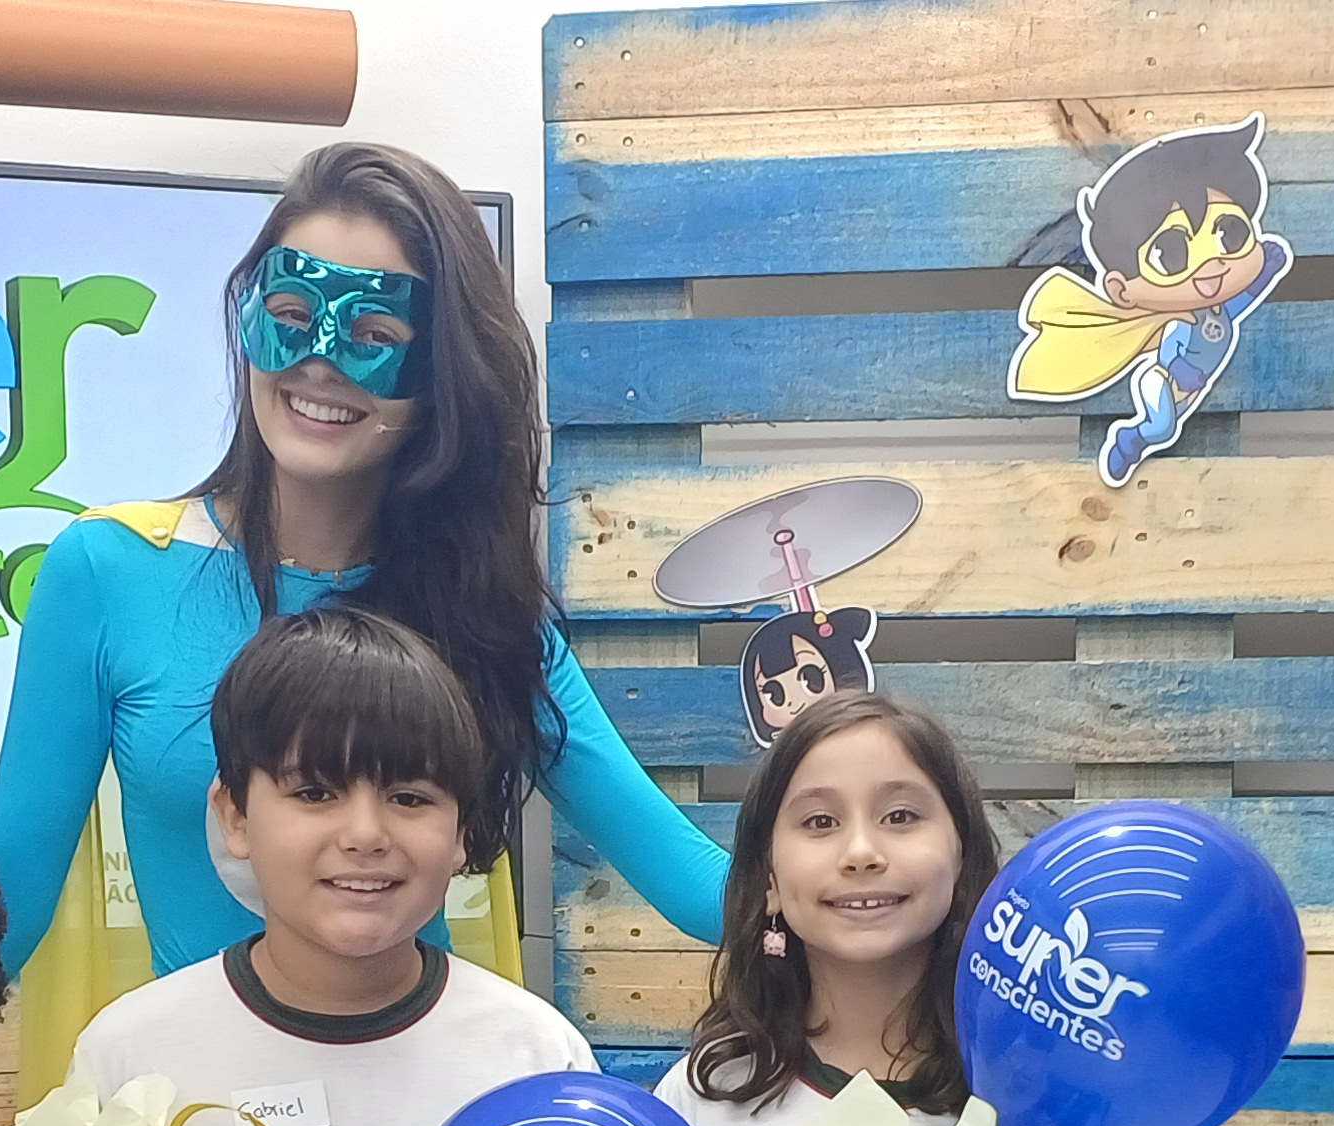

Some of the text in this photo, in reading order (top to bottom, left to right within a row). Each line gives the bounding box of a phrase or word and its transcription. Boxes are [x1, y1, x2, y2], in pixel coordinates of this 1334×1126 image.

[969, 952, 1125, 1061] conscientes
[984, 900, 1150, 1018] super
[237, 1097, 304, 1121] Gabriel
